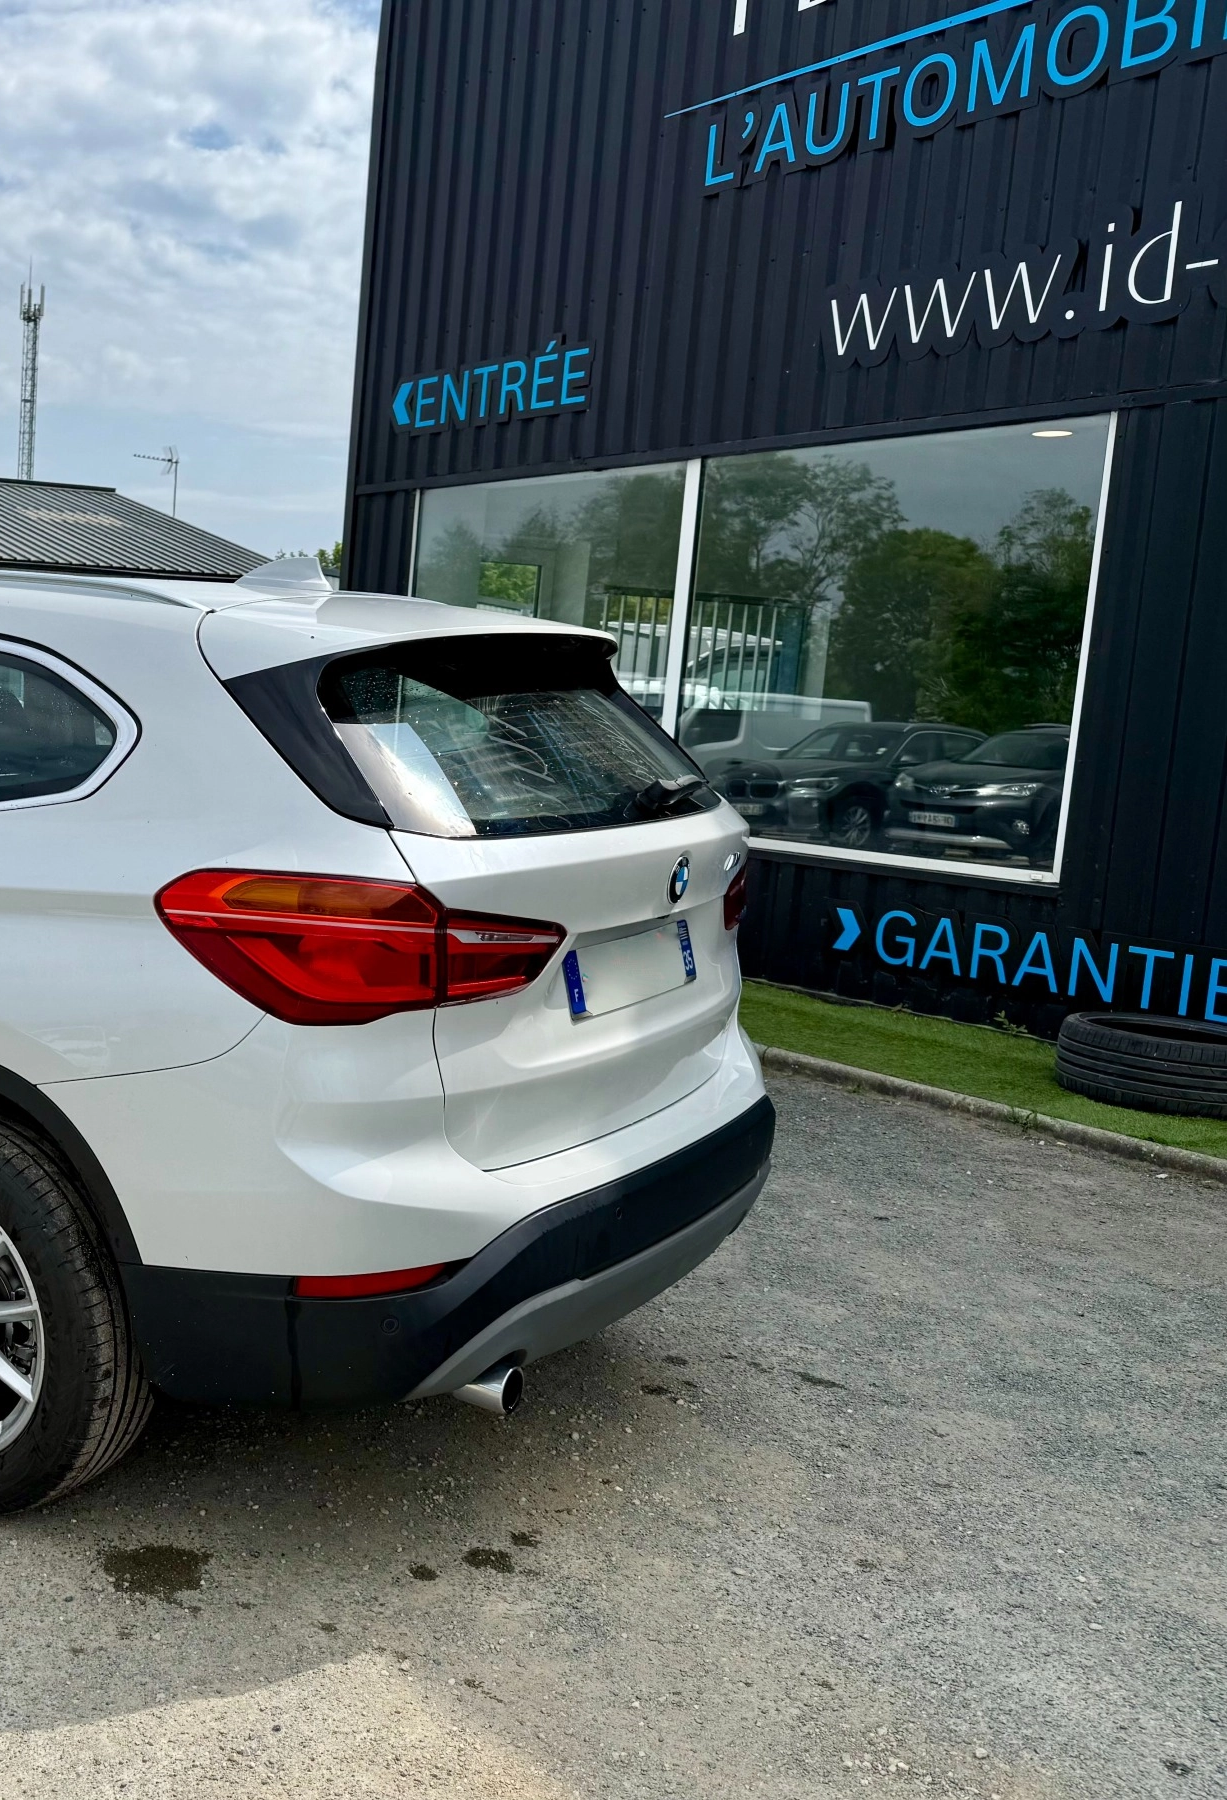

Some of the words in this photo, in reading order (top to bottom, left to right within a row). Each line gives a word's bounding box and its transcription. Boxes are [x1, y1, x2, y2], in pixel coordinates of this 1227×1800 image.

[705, 0, 1227, 187] L'AUTOMOBI
[415, 340, 590, 428] ENTRÉE
[573, 988, 579, 1003] F
